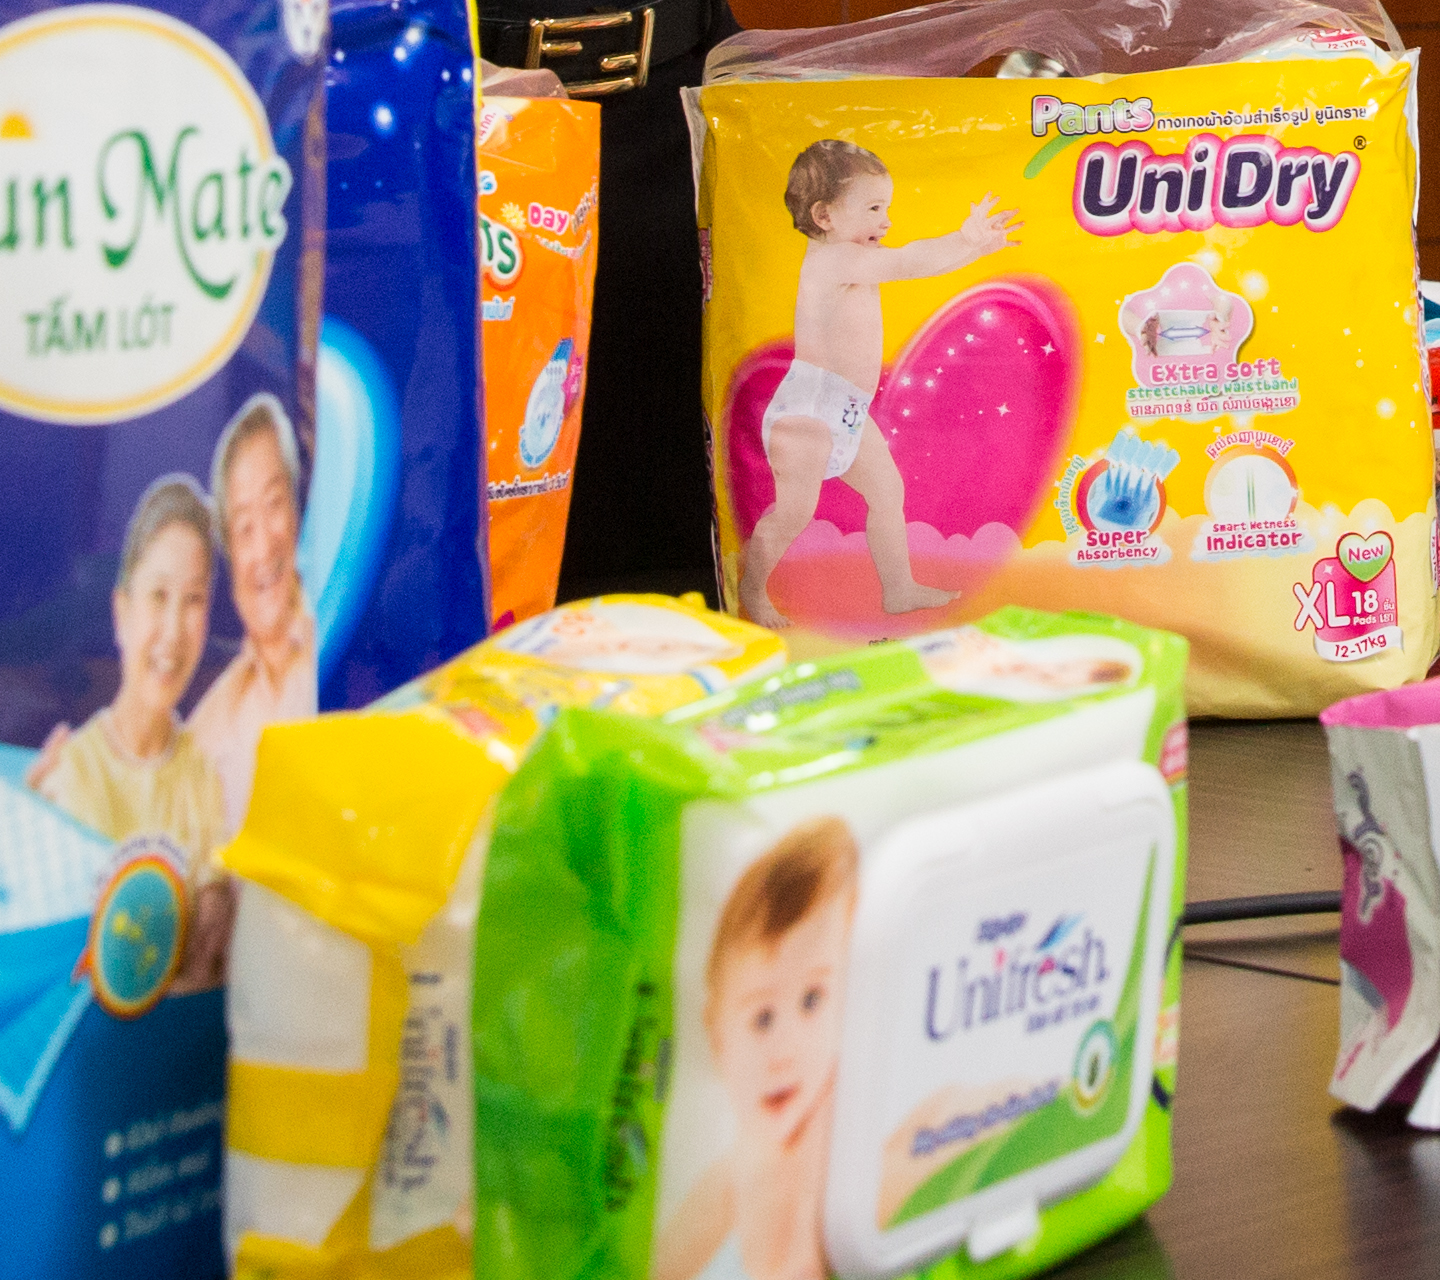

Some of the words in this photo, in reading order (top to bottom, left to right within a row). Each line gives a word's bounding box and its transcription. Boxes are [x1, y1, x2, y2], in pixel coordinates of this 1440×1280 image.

[1031, 94, 1156, 137] Pants
[1075, 137, 1359, 234] UniDry
[97, 125, 288, 302] Mate
[24, 296, 107, 358] TẤM
[117, 292, 176, 352] LÓT
[1226, 357, 1281, 379] soft
[1085, 529, 1149, 548] Super
[1206, 530, 1303, 552] Indicator
[1076, 546, 1159, 561] Absorbency
[1347, 543, 1385, 565] New
[1293, 580, 1352, 632] XL
[1351, 589, 1380, 615] 18
[1352, 614, 1378, 626] Pads
[1333, 632, 1388, 659] 12-17kg
[924, 928, 1110, 1043] Unifresh
